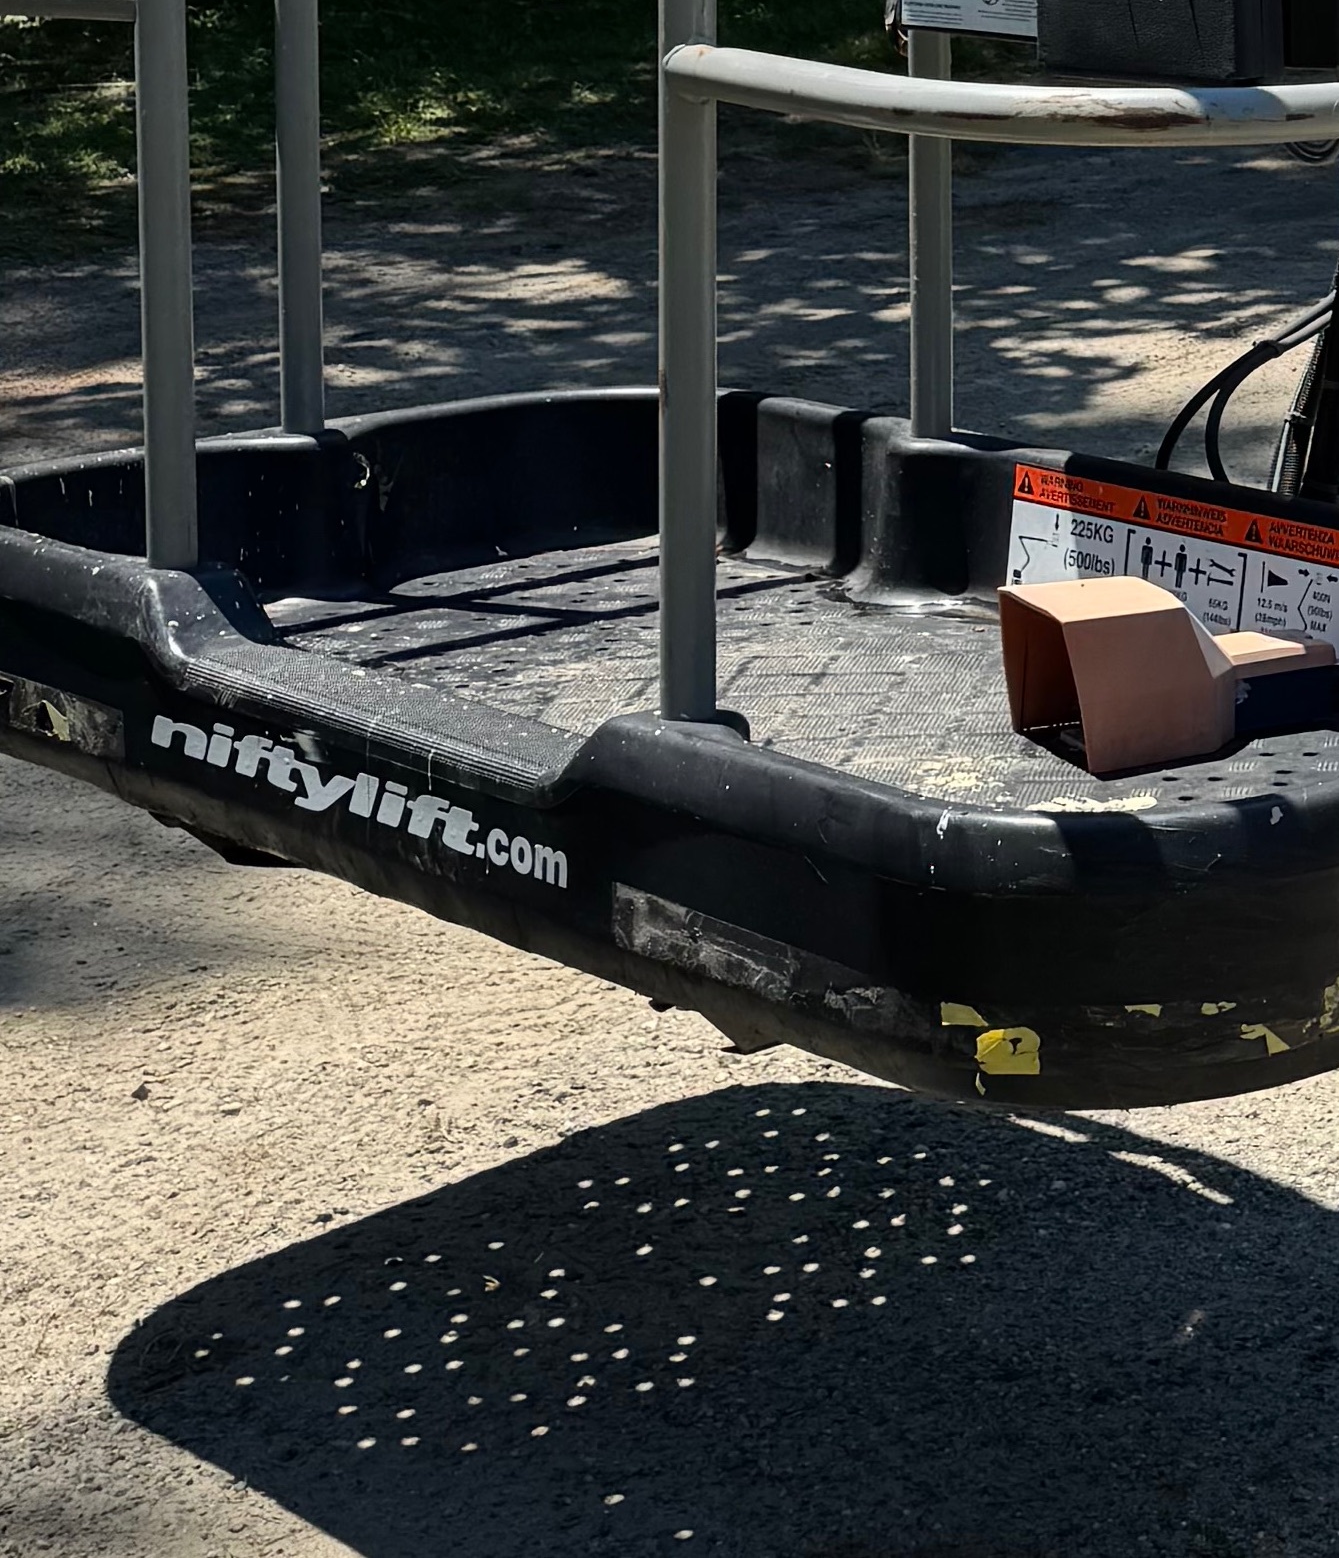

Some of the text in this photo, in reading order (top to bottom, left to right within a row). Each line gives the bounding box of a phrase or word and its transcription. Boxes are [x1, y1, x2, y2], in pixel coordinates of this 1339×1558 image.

[1040, 475, 1084, 493] WARNING
[1039, 488, 1116, 513] AVERTISSEMENT
[1070, 518, 1114, 543] 225KG
[1269, 523, 1335, 545] AVVERTENZA
[1063, 548, 1115, 576] (500lbs)
[1257, 598, 1273, 611] 12.5
[151, 715, 568, 889] niftylift.com
